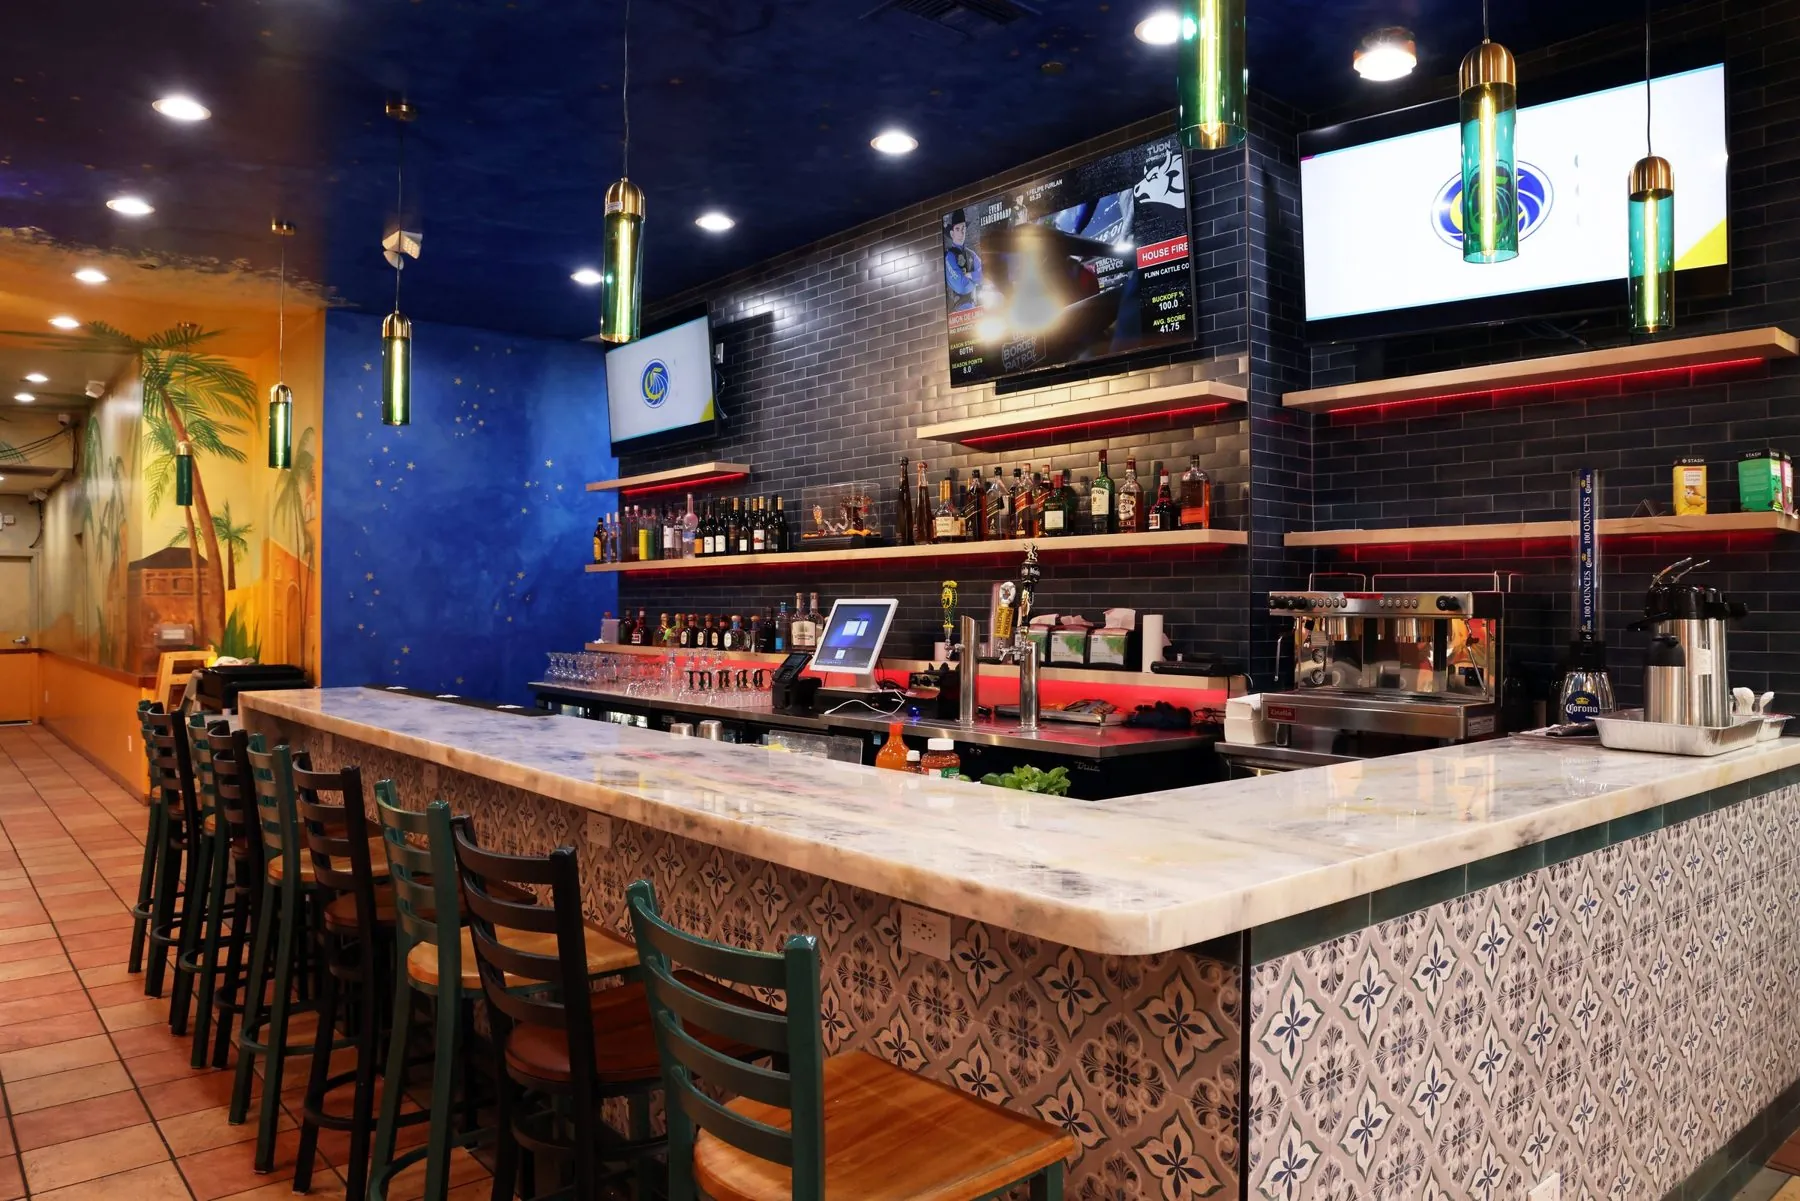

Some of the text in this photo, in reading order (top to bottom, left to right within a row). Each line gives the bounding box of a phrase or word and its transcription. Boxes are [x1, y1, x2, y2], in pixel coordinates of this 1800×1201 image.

[1147, 140, 1171, 156] TUDN
[988, 202, 1003, 214] EVENT
[1142, 242, 1188, 262] HOUSE FIRE
[1144, 269, 1160, 279] FLINN
[1160, 265, 1180, 276] CATTLE
[1152, 291, 1178, 303] BUCKOFF
[1159, 299, 1179, 311] 100.0
[1153, 314, 1186, 327] AVG. SCORE
[1160, 321, 1180, 334] 41.75
[1003, 336, 1037, 360] BORDER
[969, 357, 983, 365] POINTS
[1005, 350, 1037, 373] PATROL
[1583, 496, 1591, 532] OUNCES
[1583, 570, 1591, 605] OUNCES
[1565, 703, 1599, 714] Corona
